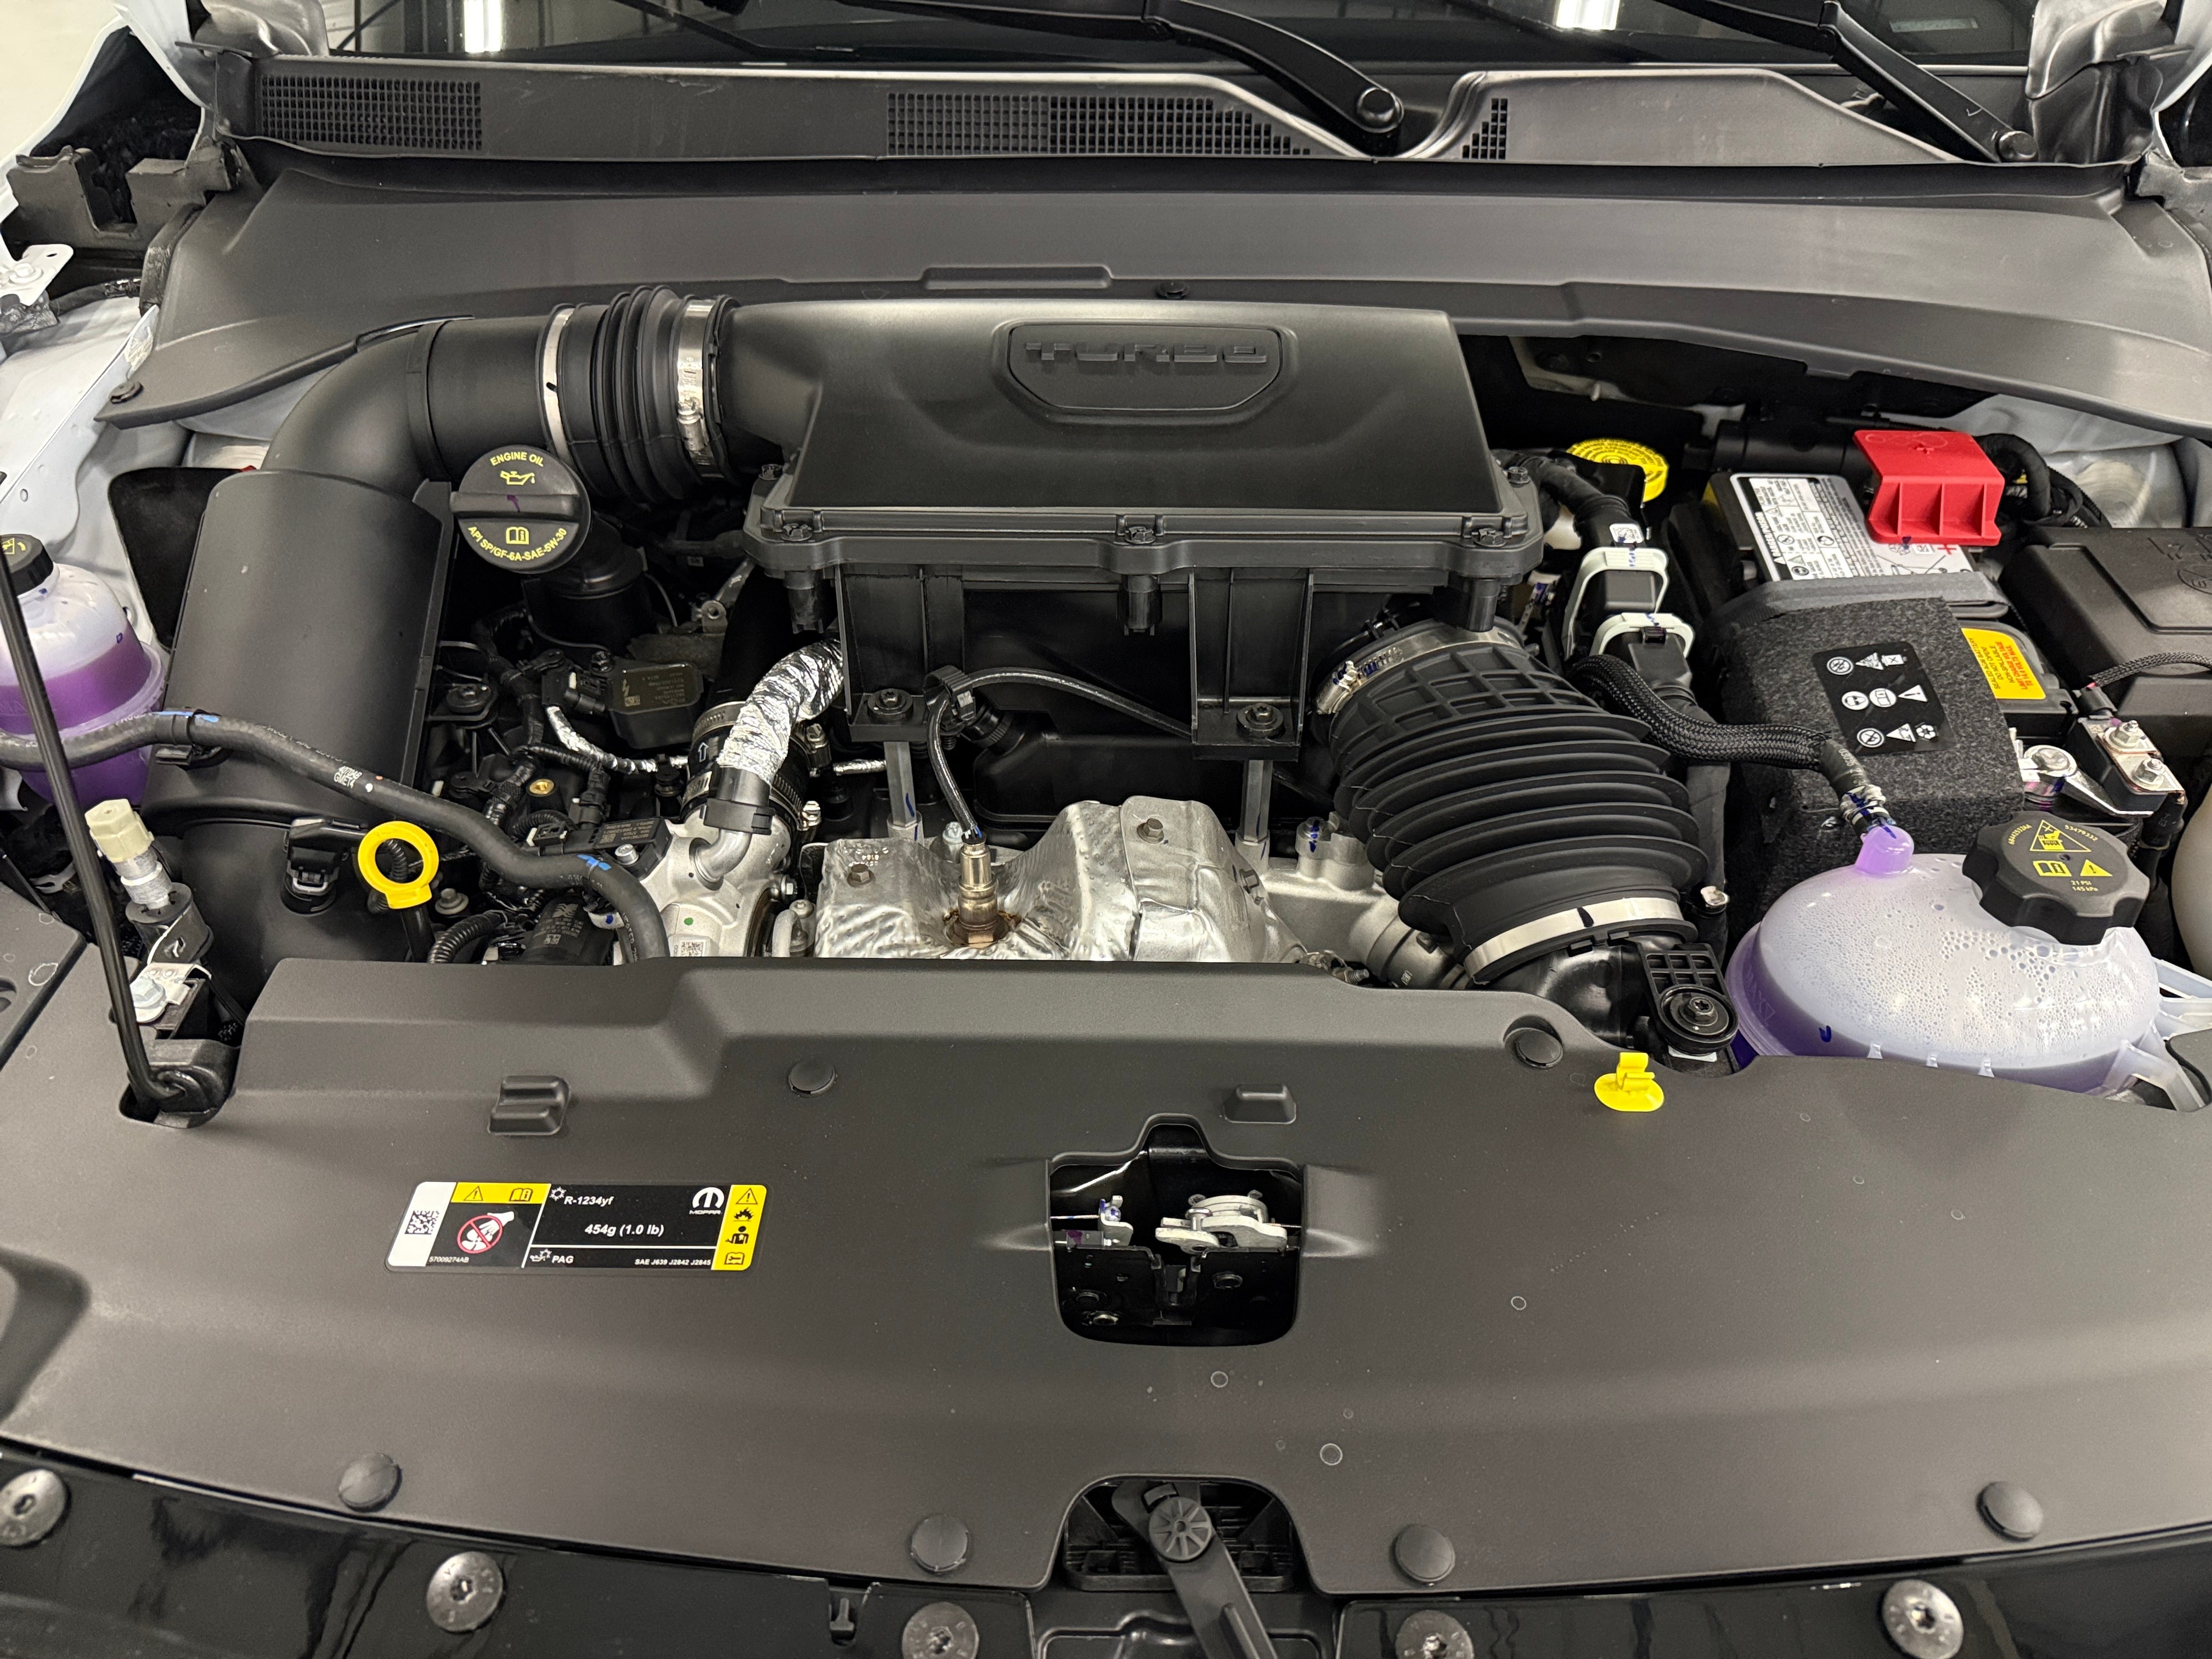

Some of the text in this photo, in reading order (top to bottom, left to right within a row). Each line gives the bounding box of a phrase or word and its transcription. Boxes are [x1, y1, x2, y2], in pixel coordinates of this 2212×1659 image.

[1023, 340, 1267, 363] TURBO
[490, 452, 545, 467] ENGINE OIL
[468, 526, 481, 543] API
[1754, 511, 1782, 557] DANGER/POISON
[1968, 637, 1984, 658] BATTERY
[1989, 662, 1998, 672] NOT
[2064, 825, 2098, 842] 53479332
[564, 1196, 614, 1206] R-1234yf
[584, 1224, 664, 1237] 454g (1.0 lb)
[551, 1255, 574, 1265] PAG
